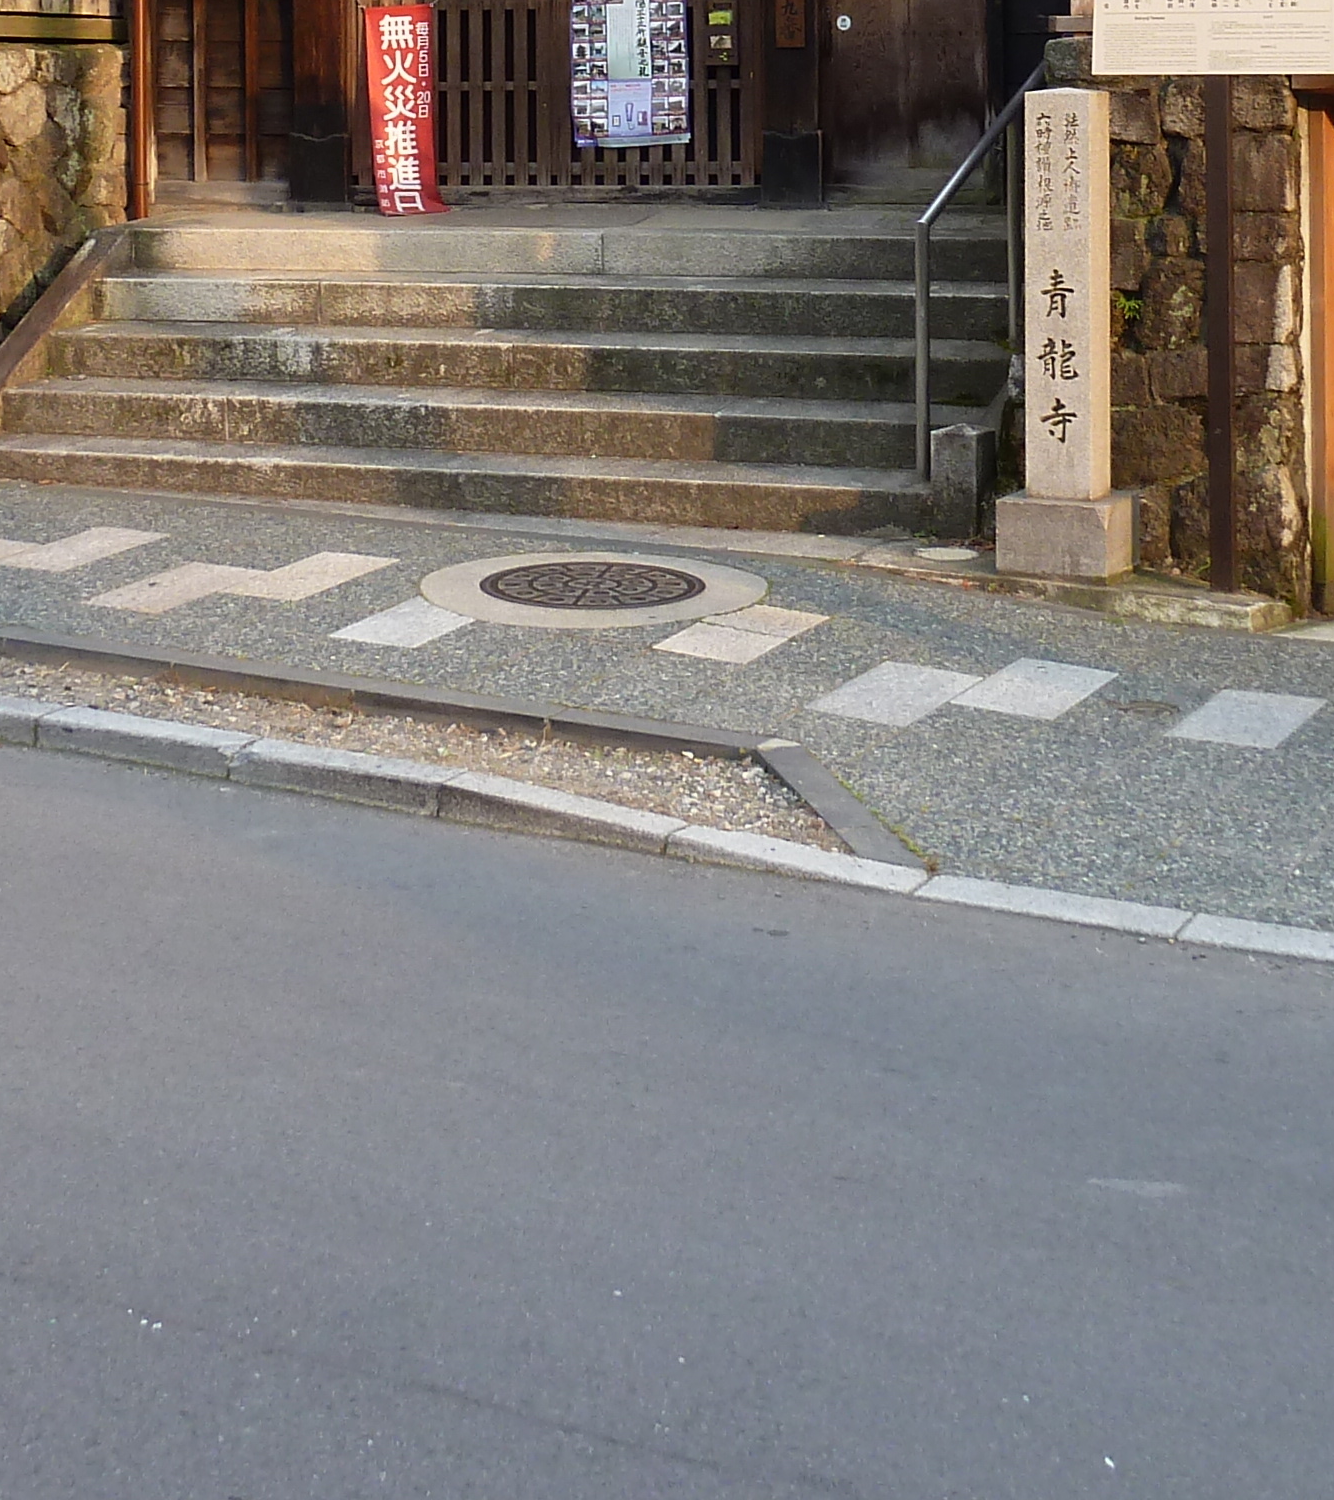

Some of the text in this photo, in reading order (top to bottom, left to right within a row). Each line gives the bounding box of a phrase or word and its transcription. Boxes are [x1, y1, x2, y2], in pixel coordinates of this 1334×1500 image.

[378, 14, 425, 212] 無火災推進日
[1036, 269, 1080, 444] 青龍寺
